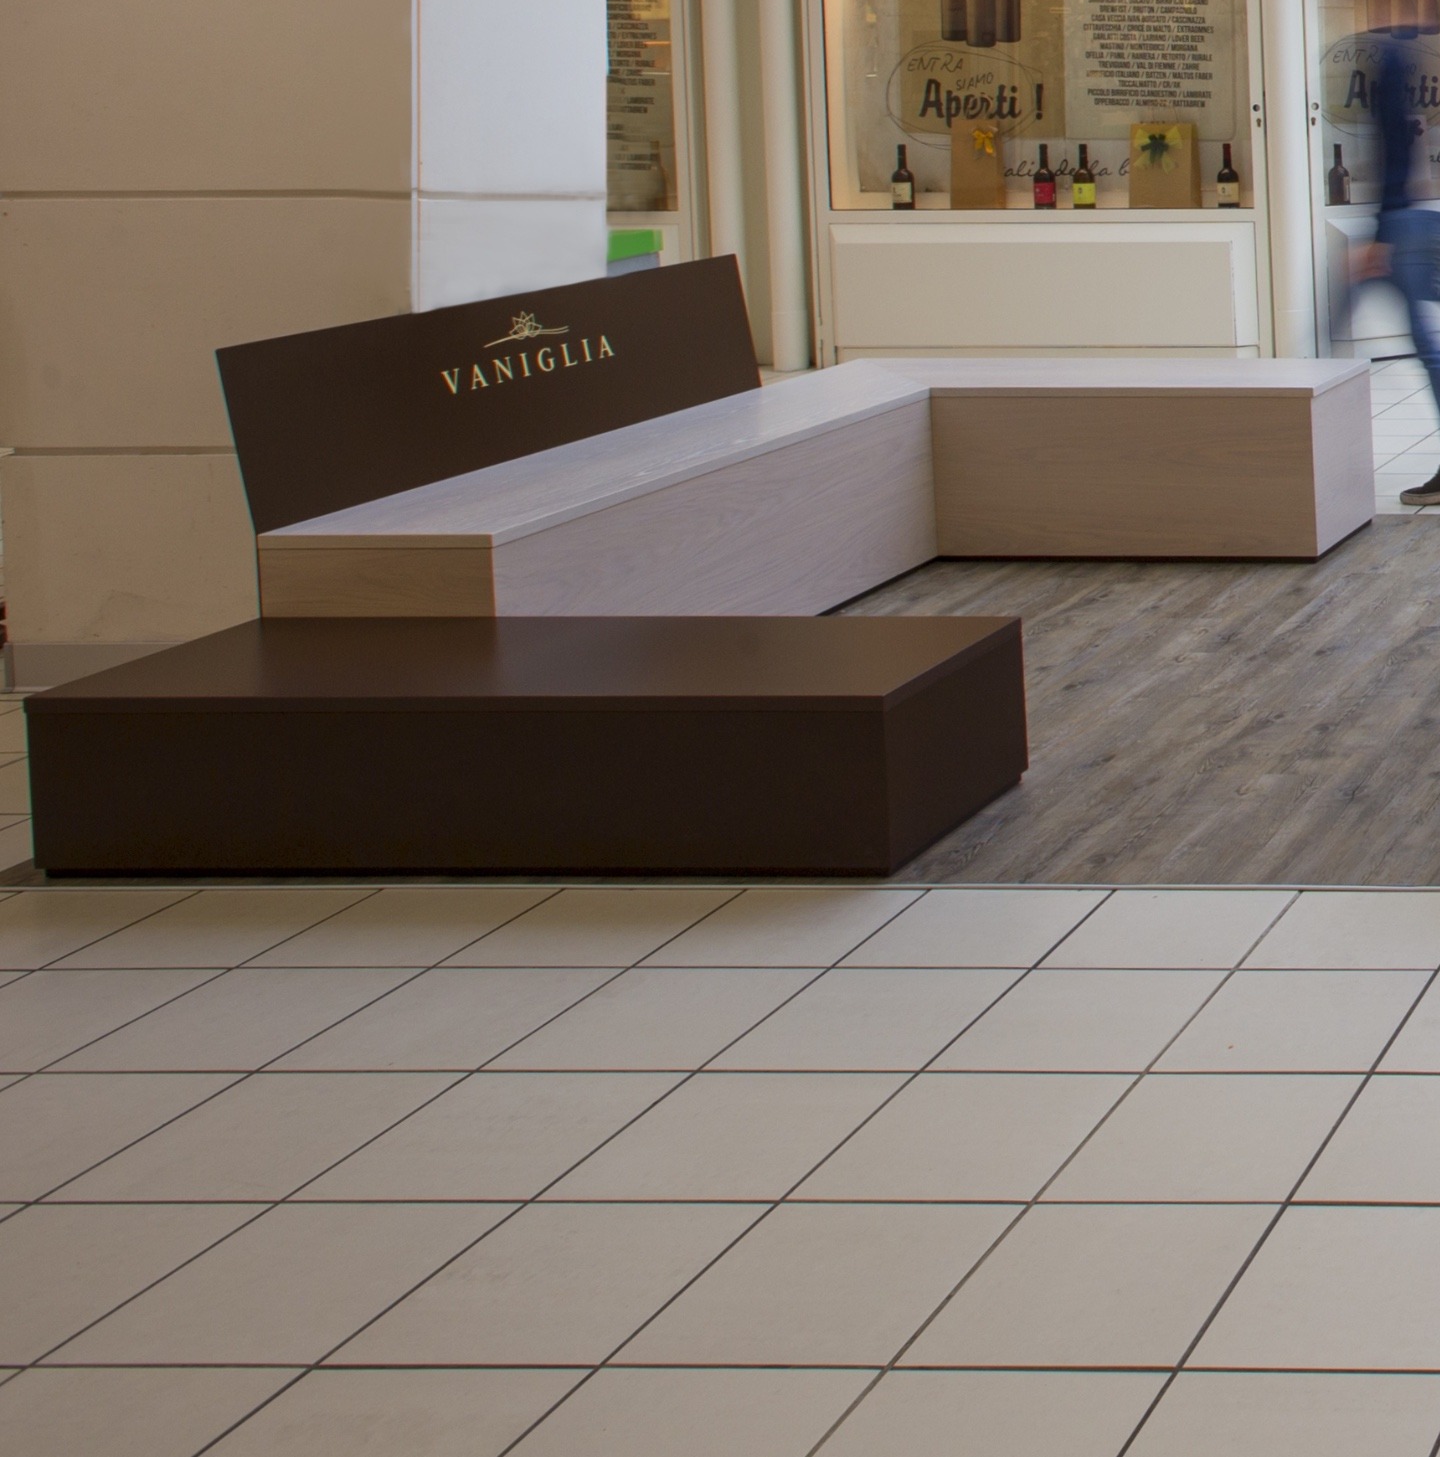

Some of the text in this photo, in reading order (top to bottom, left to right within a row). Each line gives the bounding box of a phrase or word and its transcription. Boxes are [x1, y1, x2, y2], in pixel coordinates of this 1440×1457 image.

[907, 53, 964, 72] ENTRA
[955, 72, 994, 91] SIAMO
[918, 78, 1022, 128] Aperti
[440, 334, 616, 396] VANIGLIA
